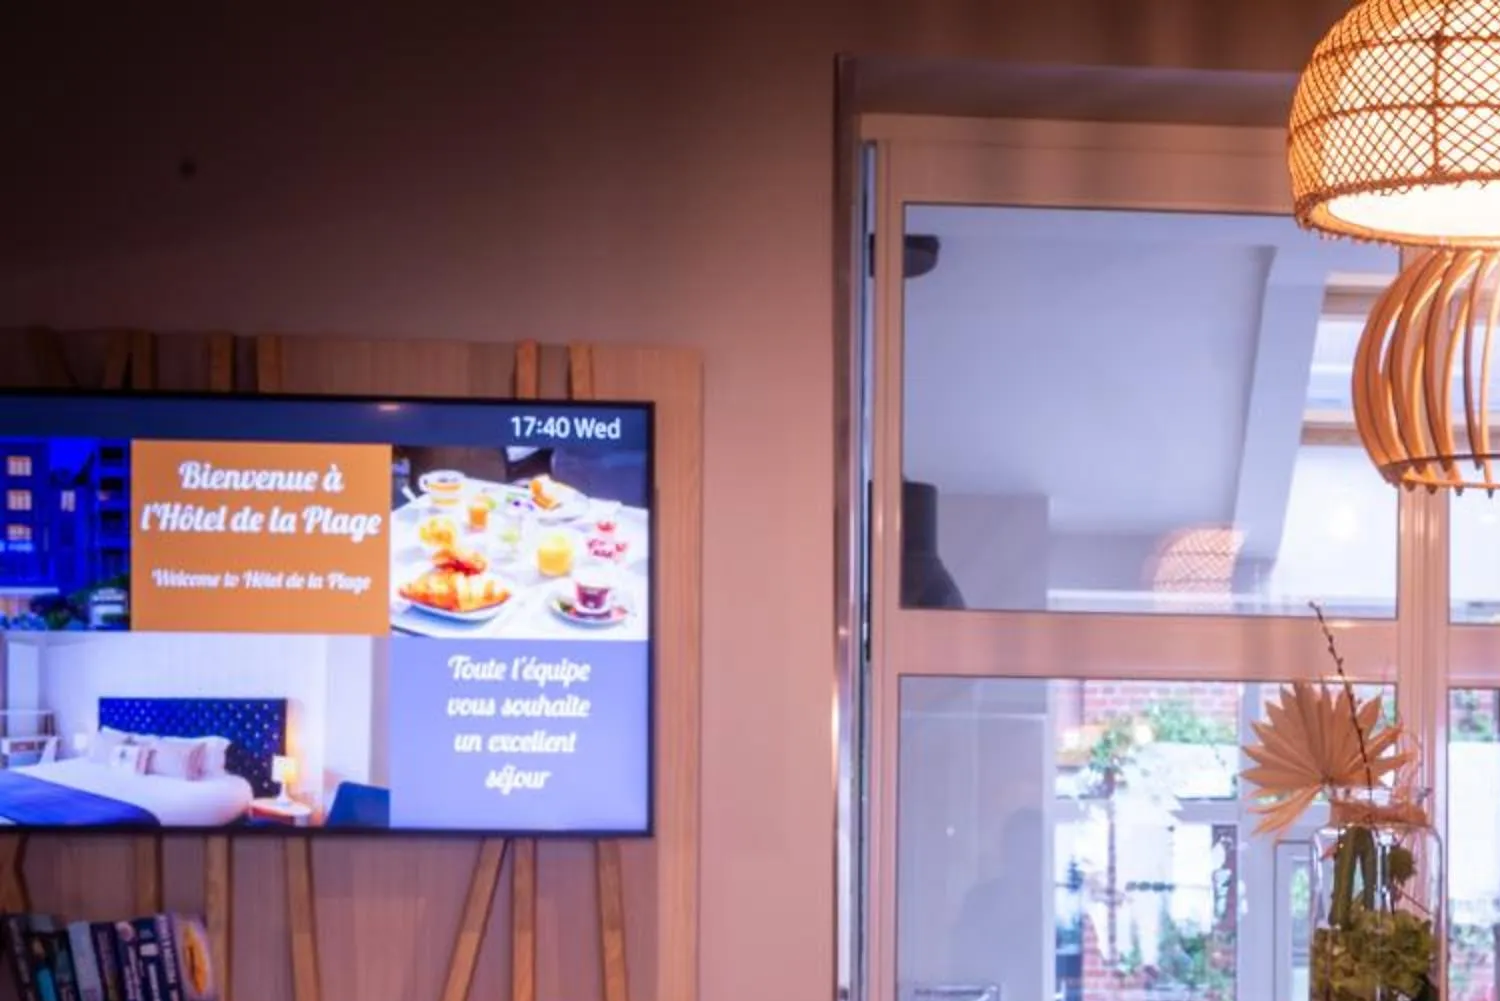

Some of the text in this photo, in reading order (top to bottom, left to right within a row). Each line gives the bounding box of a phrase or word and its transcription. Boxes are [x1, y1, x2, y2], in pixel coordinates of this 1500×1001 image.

[511, 415, 621, 439] 17:40 Wed
[178, 461, 345, 493] Bienvenue à
[140, 503, 383, 543] l'Hôtel de la Plage
[223, 571, 240, 588] to
[285, 572, 305, 589] de
[307, 572, 324, 589] la
[325, 573, 372, 595] Plage
[448, 655, 592, 688] Toute l'équipe
[447, 698, 496, 717] vous
[454, 730, 577, 753] un excellent
[485, 764, 552, 796] séjour
